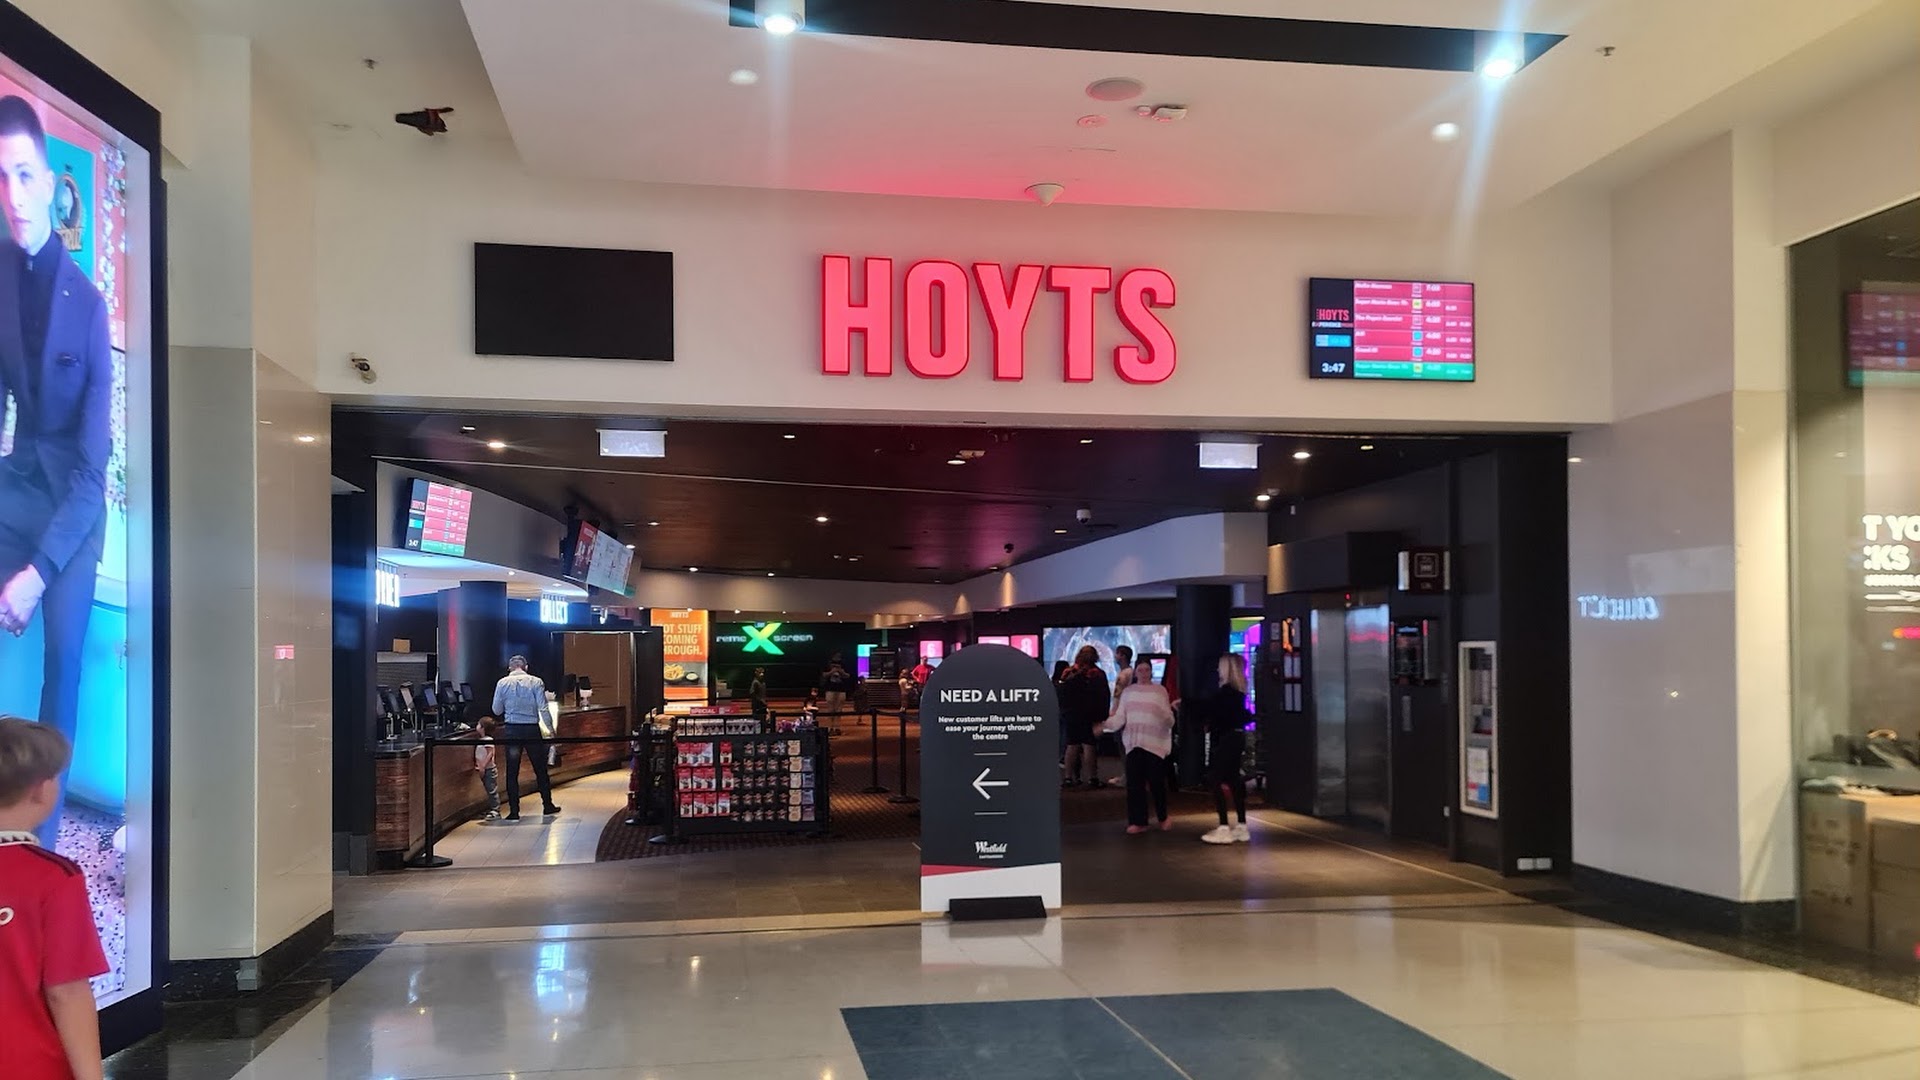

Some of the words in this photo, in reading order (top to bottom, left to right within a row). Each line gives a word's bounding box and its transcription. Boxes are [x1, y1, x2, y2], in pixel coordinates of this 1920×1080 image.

[822, 255, 1176, 384] HOYTS
[1319, 308, 1350, 321] HOYTS
[1321, 362, 1345, 373] 3:47
[663, 623, 674, 634] OT
[677, 623, 702, 634] STUFF
[664, 645, 702, 655] HROUGH.
[926, 643, 936, 657] 6
[940, 689, 982, 703] NEED
[985, 689, 998, 703] A
[1001, 688, 1040, 703] LIFT?
[938, 715, 954, 723] New
[989, 714, 1003, 723] lifts
[962, 725, 979, 733] your
[979, 723, 1006, 733] journey
[1007, 723, 1035, 732] through
